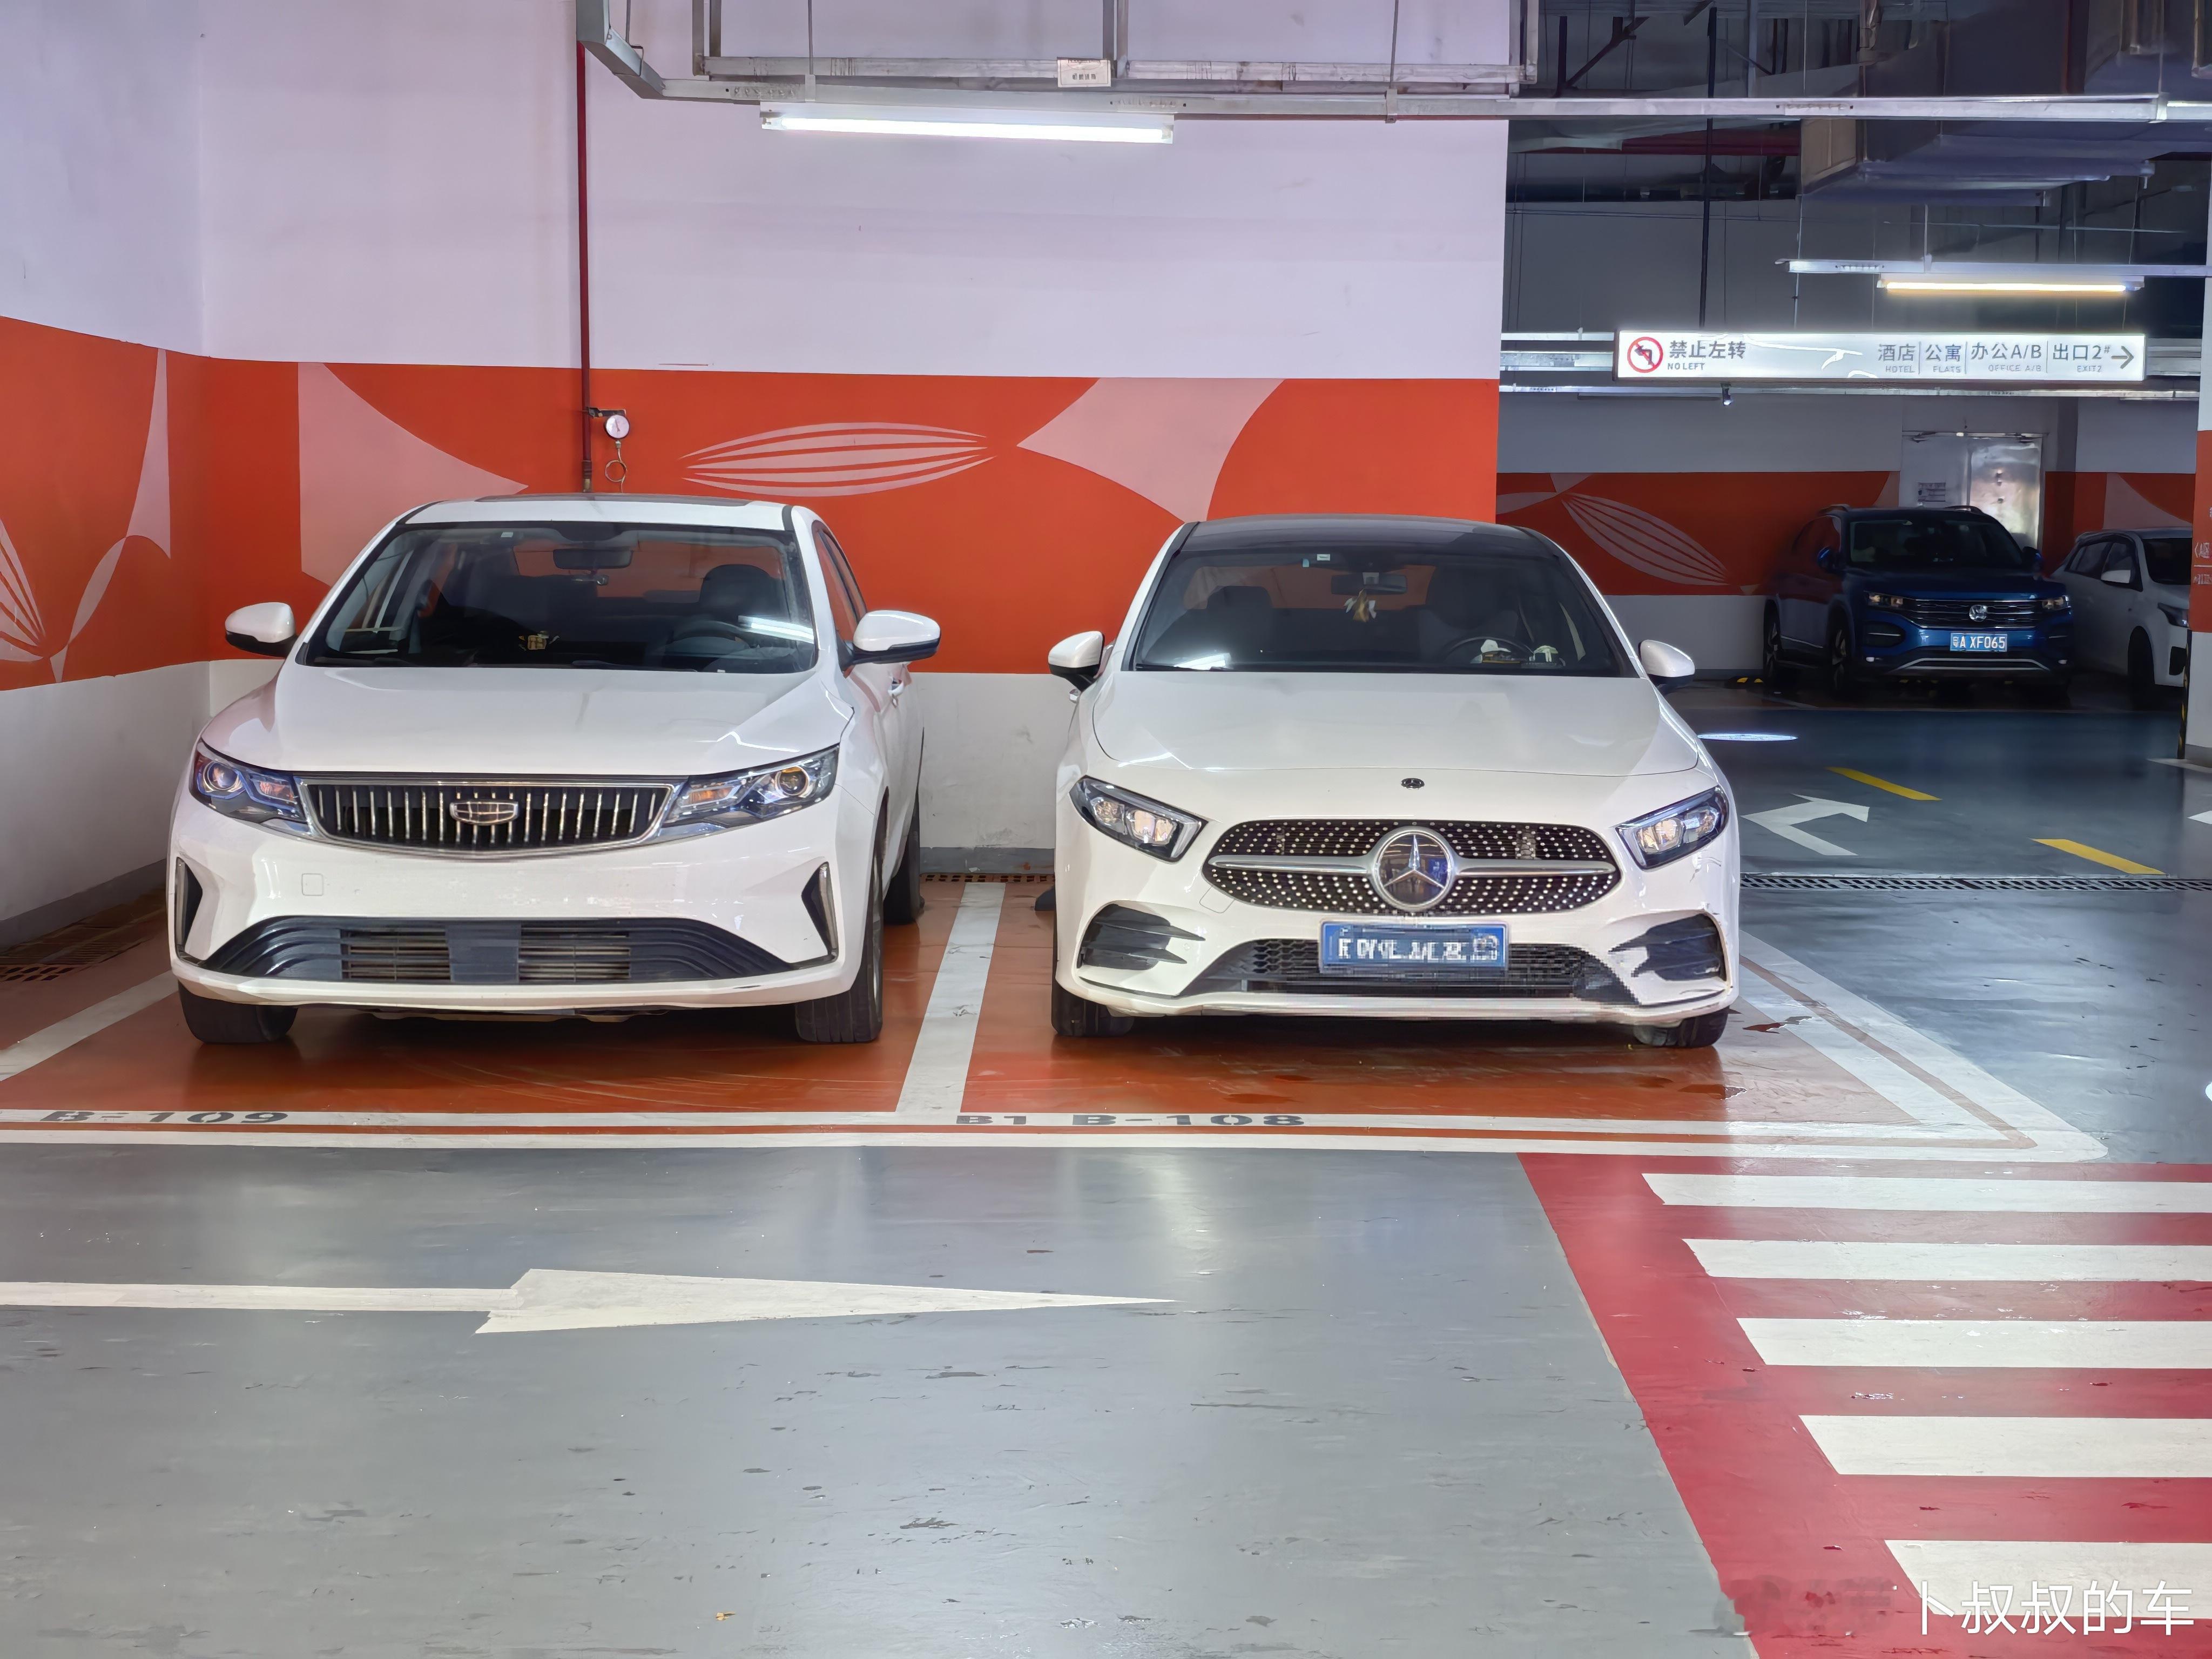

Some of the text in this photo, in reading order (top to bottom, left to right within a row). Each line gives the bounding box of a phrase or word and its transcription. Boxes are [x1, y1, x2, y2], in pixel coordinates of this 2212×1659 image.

[1669, 340, 1746, 359] 禁止左转
[1878, 343, 1917, 361] 酒店
[1925, 343, 1962, 361] 公寓
[1971, 342, 2042, 360] 办公A/B
[40, 1111, 288, 1123] B-109
[956, 1115, 1304, 1126] B1 B-108
